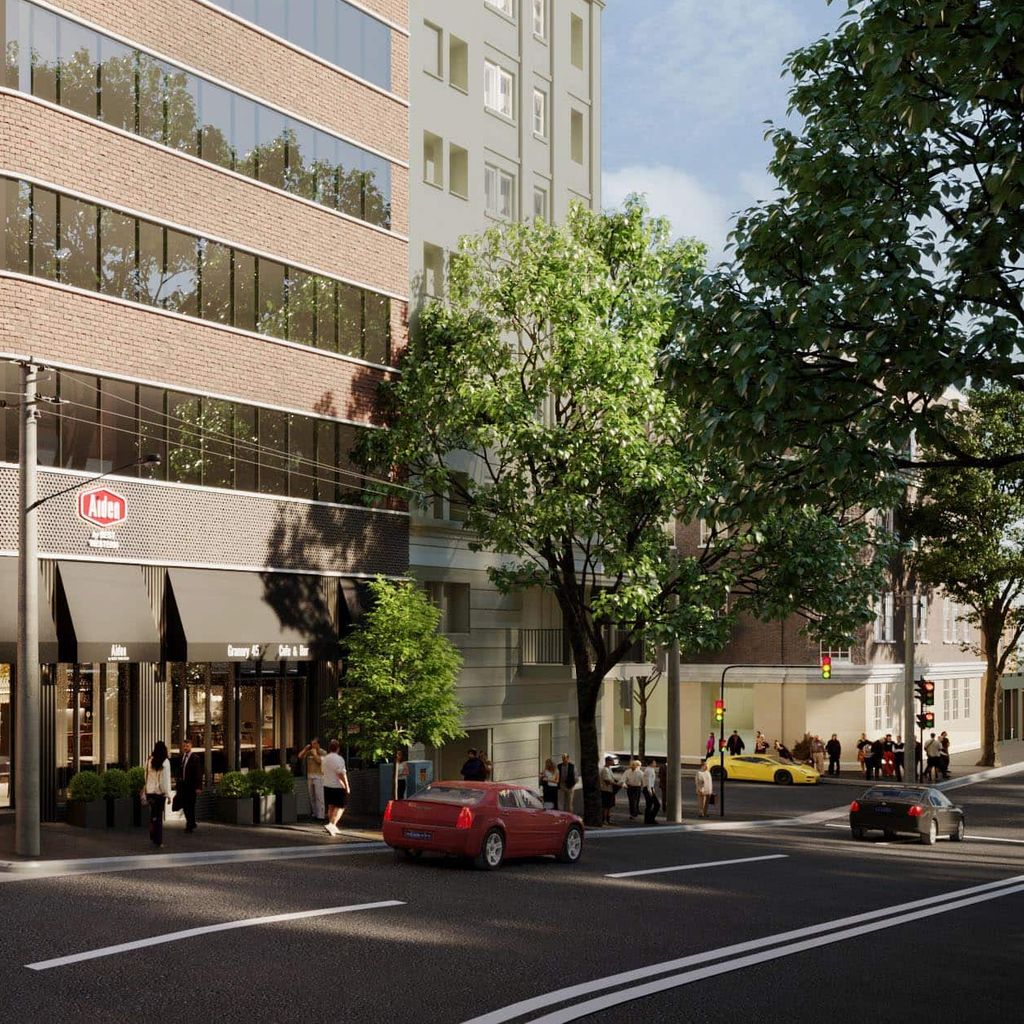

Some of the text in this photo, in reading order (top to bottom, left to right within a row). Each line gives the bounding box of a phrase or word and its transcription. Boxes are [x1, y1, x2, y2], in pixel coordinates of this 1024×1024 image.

[88, 494, 121, 520] Aiden
[110, 644, 127, 657] Aiden
[251, 644, 260, 657] 45
[278, 644, 292, 657] Cafe
[292, 645, 298, 657] &
[299, 644, 309, 657] Bar
